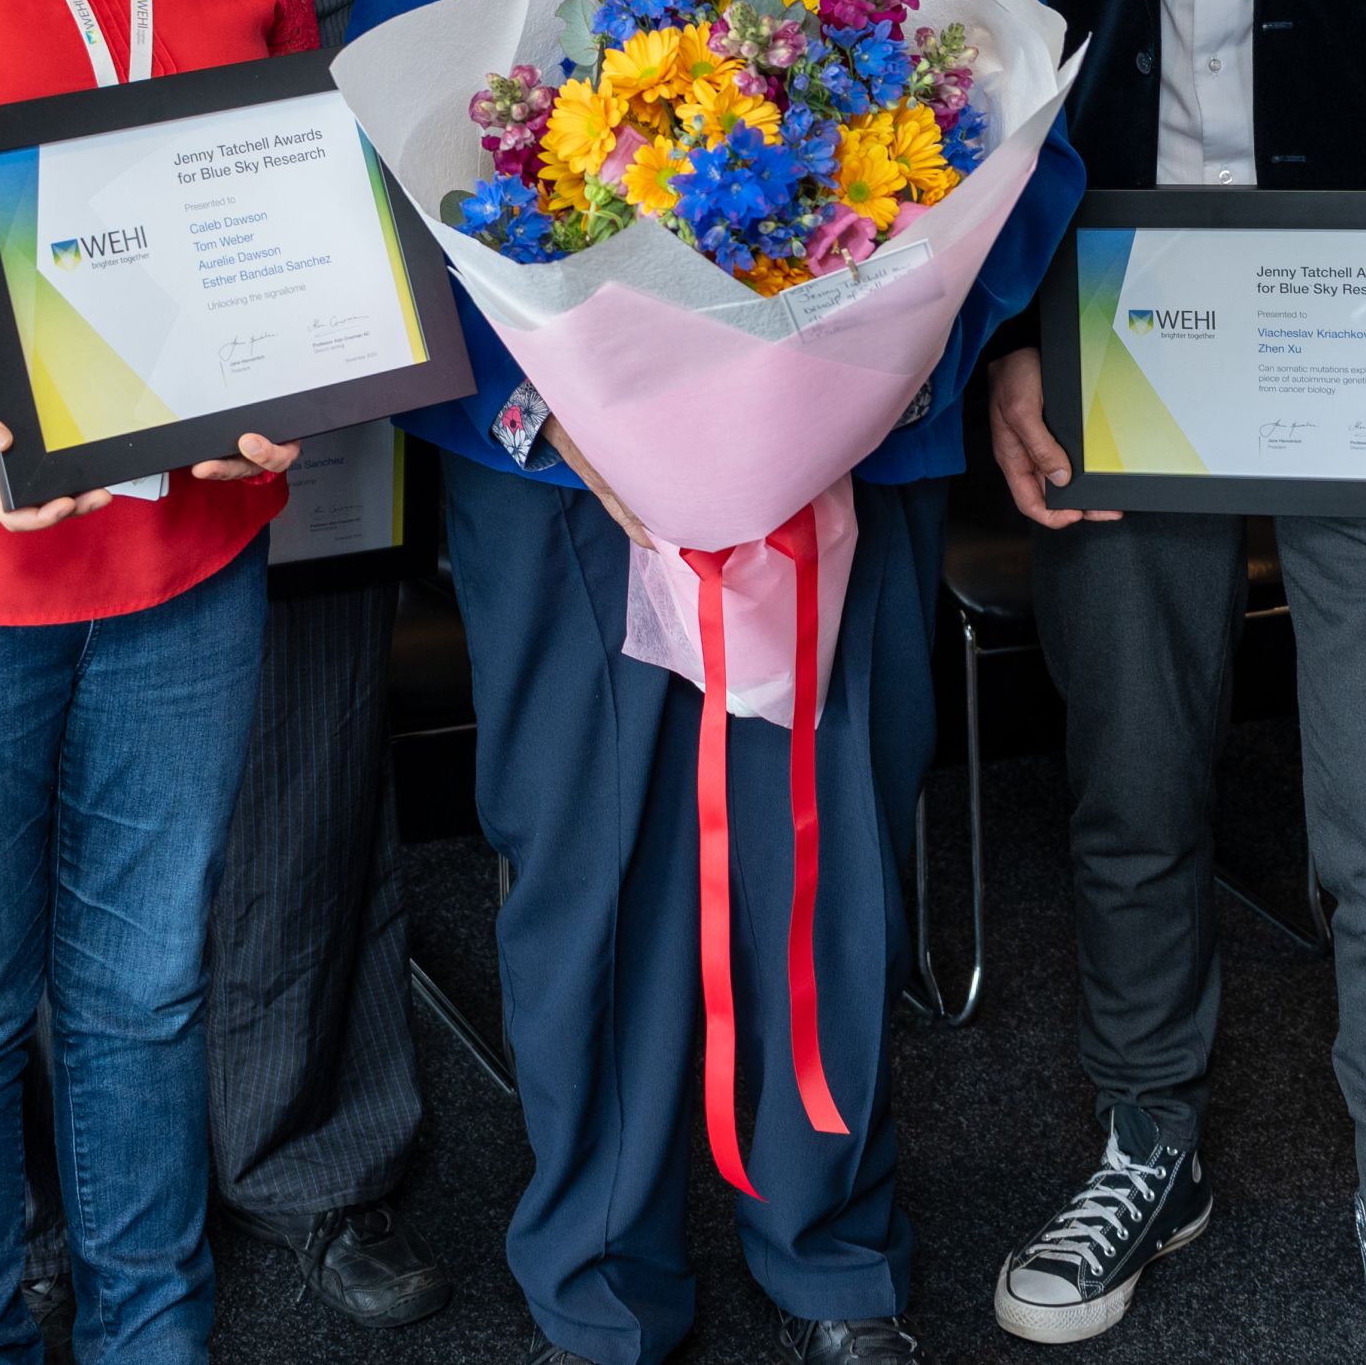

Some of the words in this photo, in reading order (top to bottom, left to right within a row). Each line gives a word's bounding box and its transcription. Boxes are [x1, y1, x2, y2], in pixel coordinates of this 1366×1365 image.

[73, 0, 95, 31] WEHI
[136, 0, 148, 30] WEHI
[173, 150, 214, 166] Jenny
[217, 137, 270, 158] Tatchell
[274, 128, 323, 148] Awards
[178, 171, 197, 184] for
[201, 165, 232, 180] Blue
[235, 159, 260, 174] Sky
[263, 147, 326, 169] Research
[184, 197, 225, 212] Presented
[227, 196, 236, 204] to
[189, 220, 222, 235] Caleb
[224, 211, 268, 228] Dawson
[80, 225, 148, 259] WEHI
[193, 240, 217, 253] Tom
[219, 233, 255, 248] Weber
[91, 259, 119, 270] brighter
[120, 253, 150, 264] together
[198, 255, 235, 271] Aurelie
[237, 246, 281, 263] Dawson
[202, 274, 237, 289] Esther
[239, 264, 284, 281] Bandala
[286, 255, 332, 271] Sanchez
[1257, 266, 1296, 280] Jenny
[1300, 266, 1352, 279] Tatchell
[1257, 282, 1275, 294] for
[1279, 283, 1309, 294] Blue
[1313, 283, 1338, 297] Sky
[207, 295, 248, 311] Unlocking
[249, 292, 263, 302] the
[1155, 310, 1215, 330] WEHI
[1257, 311, 1297, 319] Presented
[1299, 311, 1307, 319] to
[1161, 332, 1186, 340] brighter
[1187, 333, 1215, 341] together
[1257, 328, 1314, 338] Viacheslav
[1258, 344, 1285, 354] Zhen
[1287, 344, 1302, 354] Xu
[1258, 364, 1275, 373] Can
[1277, 365, 1308, 373] somatic
[1310, 365, 1349, 374] mutations
[1258, 375, 1280, 385] piece
[1281, 375, 1290, 383] of
[1291, 375, 1340, 384] autoimmune
[1258, 385, 1276, 393] from
[1278, 386, 1305, 394] cancer
[1307, 385, 1336, 395] biology
[304, 456, 345, 470] Sanchez
